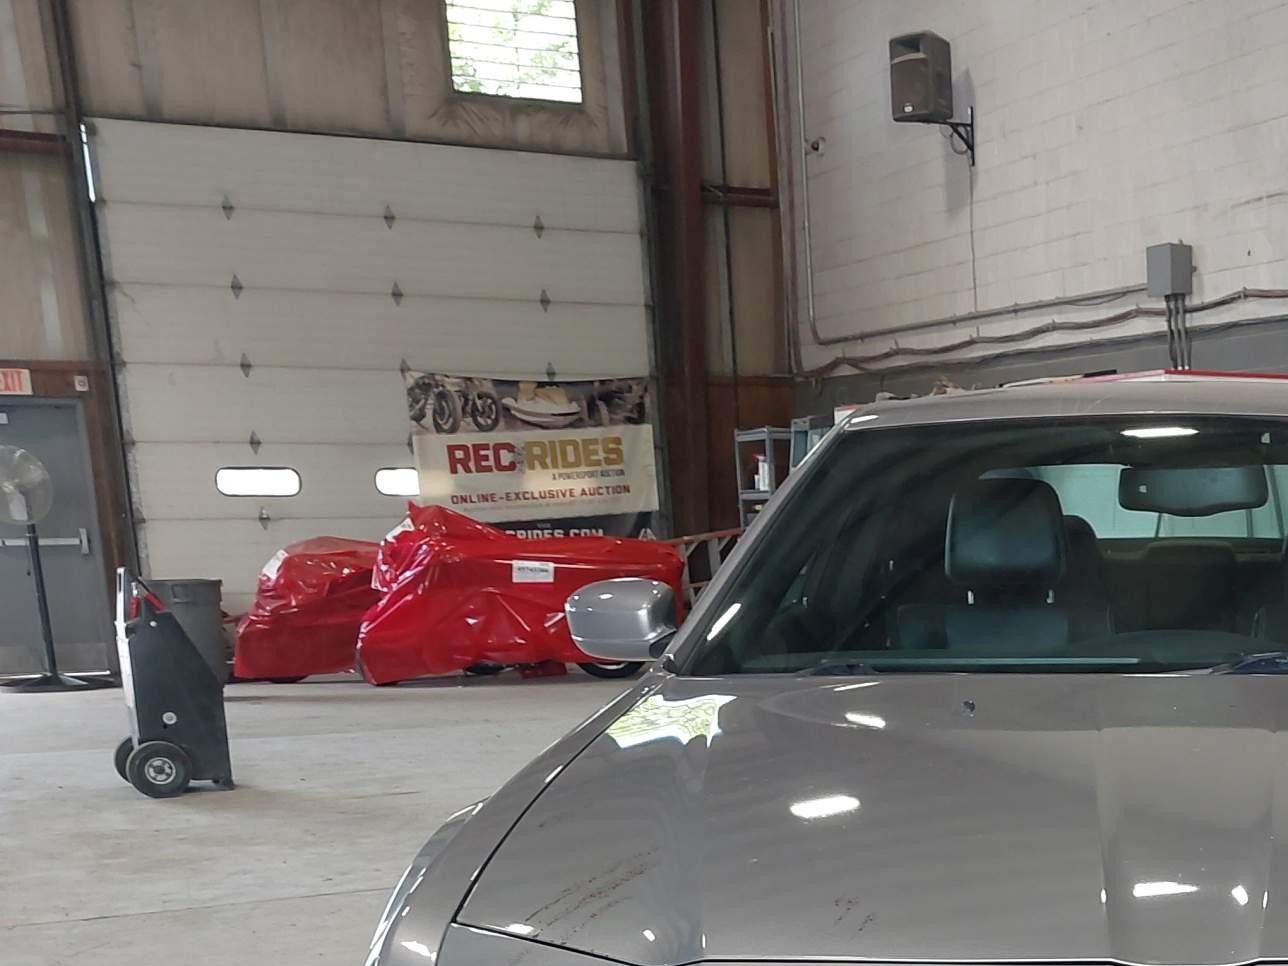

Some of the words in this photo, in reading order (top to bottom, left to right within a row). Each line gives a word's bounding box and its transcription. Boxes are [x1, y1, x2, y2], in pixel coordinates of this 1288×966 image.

[0, 370, 23, 392] XIT
[446, 442, 517, 475] REC
[523, 436, 625, 472] RIDES
[451, 487, 576, 505] ONLINE-EXCLUSIVE
[580, 484, 631, 497] AUCTION
